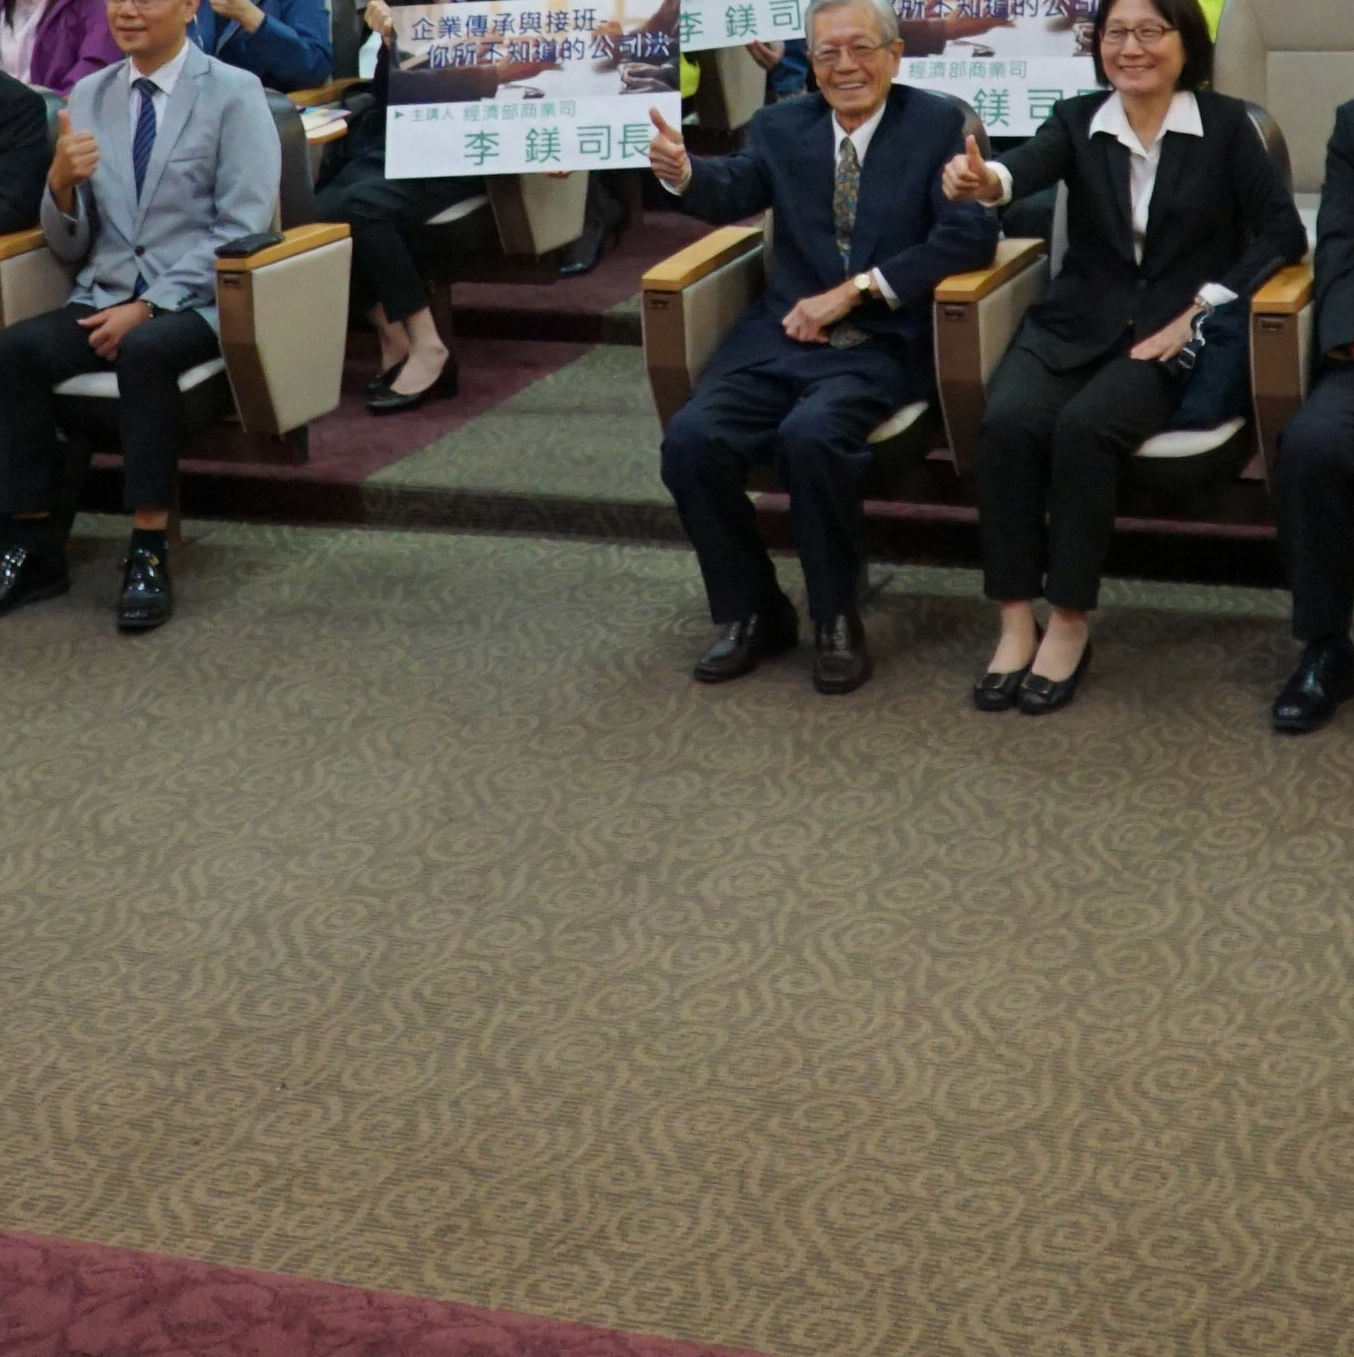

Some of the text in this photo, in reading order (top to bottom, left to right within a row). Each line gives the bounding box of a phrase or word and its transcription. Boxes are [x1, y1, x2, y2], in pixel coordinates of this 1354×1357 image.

[411, 8, 609, 41] 企業傳承與接班-
[725, 3, 758, 38] 鎂
[428, 31, 671, 68] 你所不知道的公司法
[908, 60, 1027, 80] 經濟部商業司
[463, 100, 576, 122] 經濟部商業司
[463, 123, 652, 166] 李 鎂 司長
